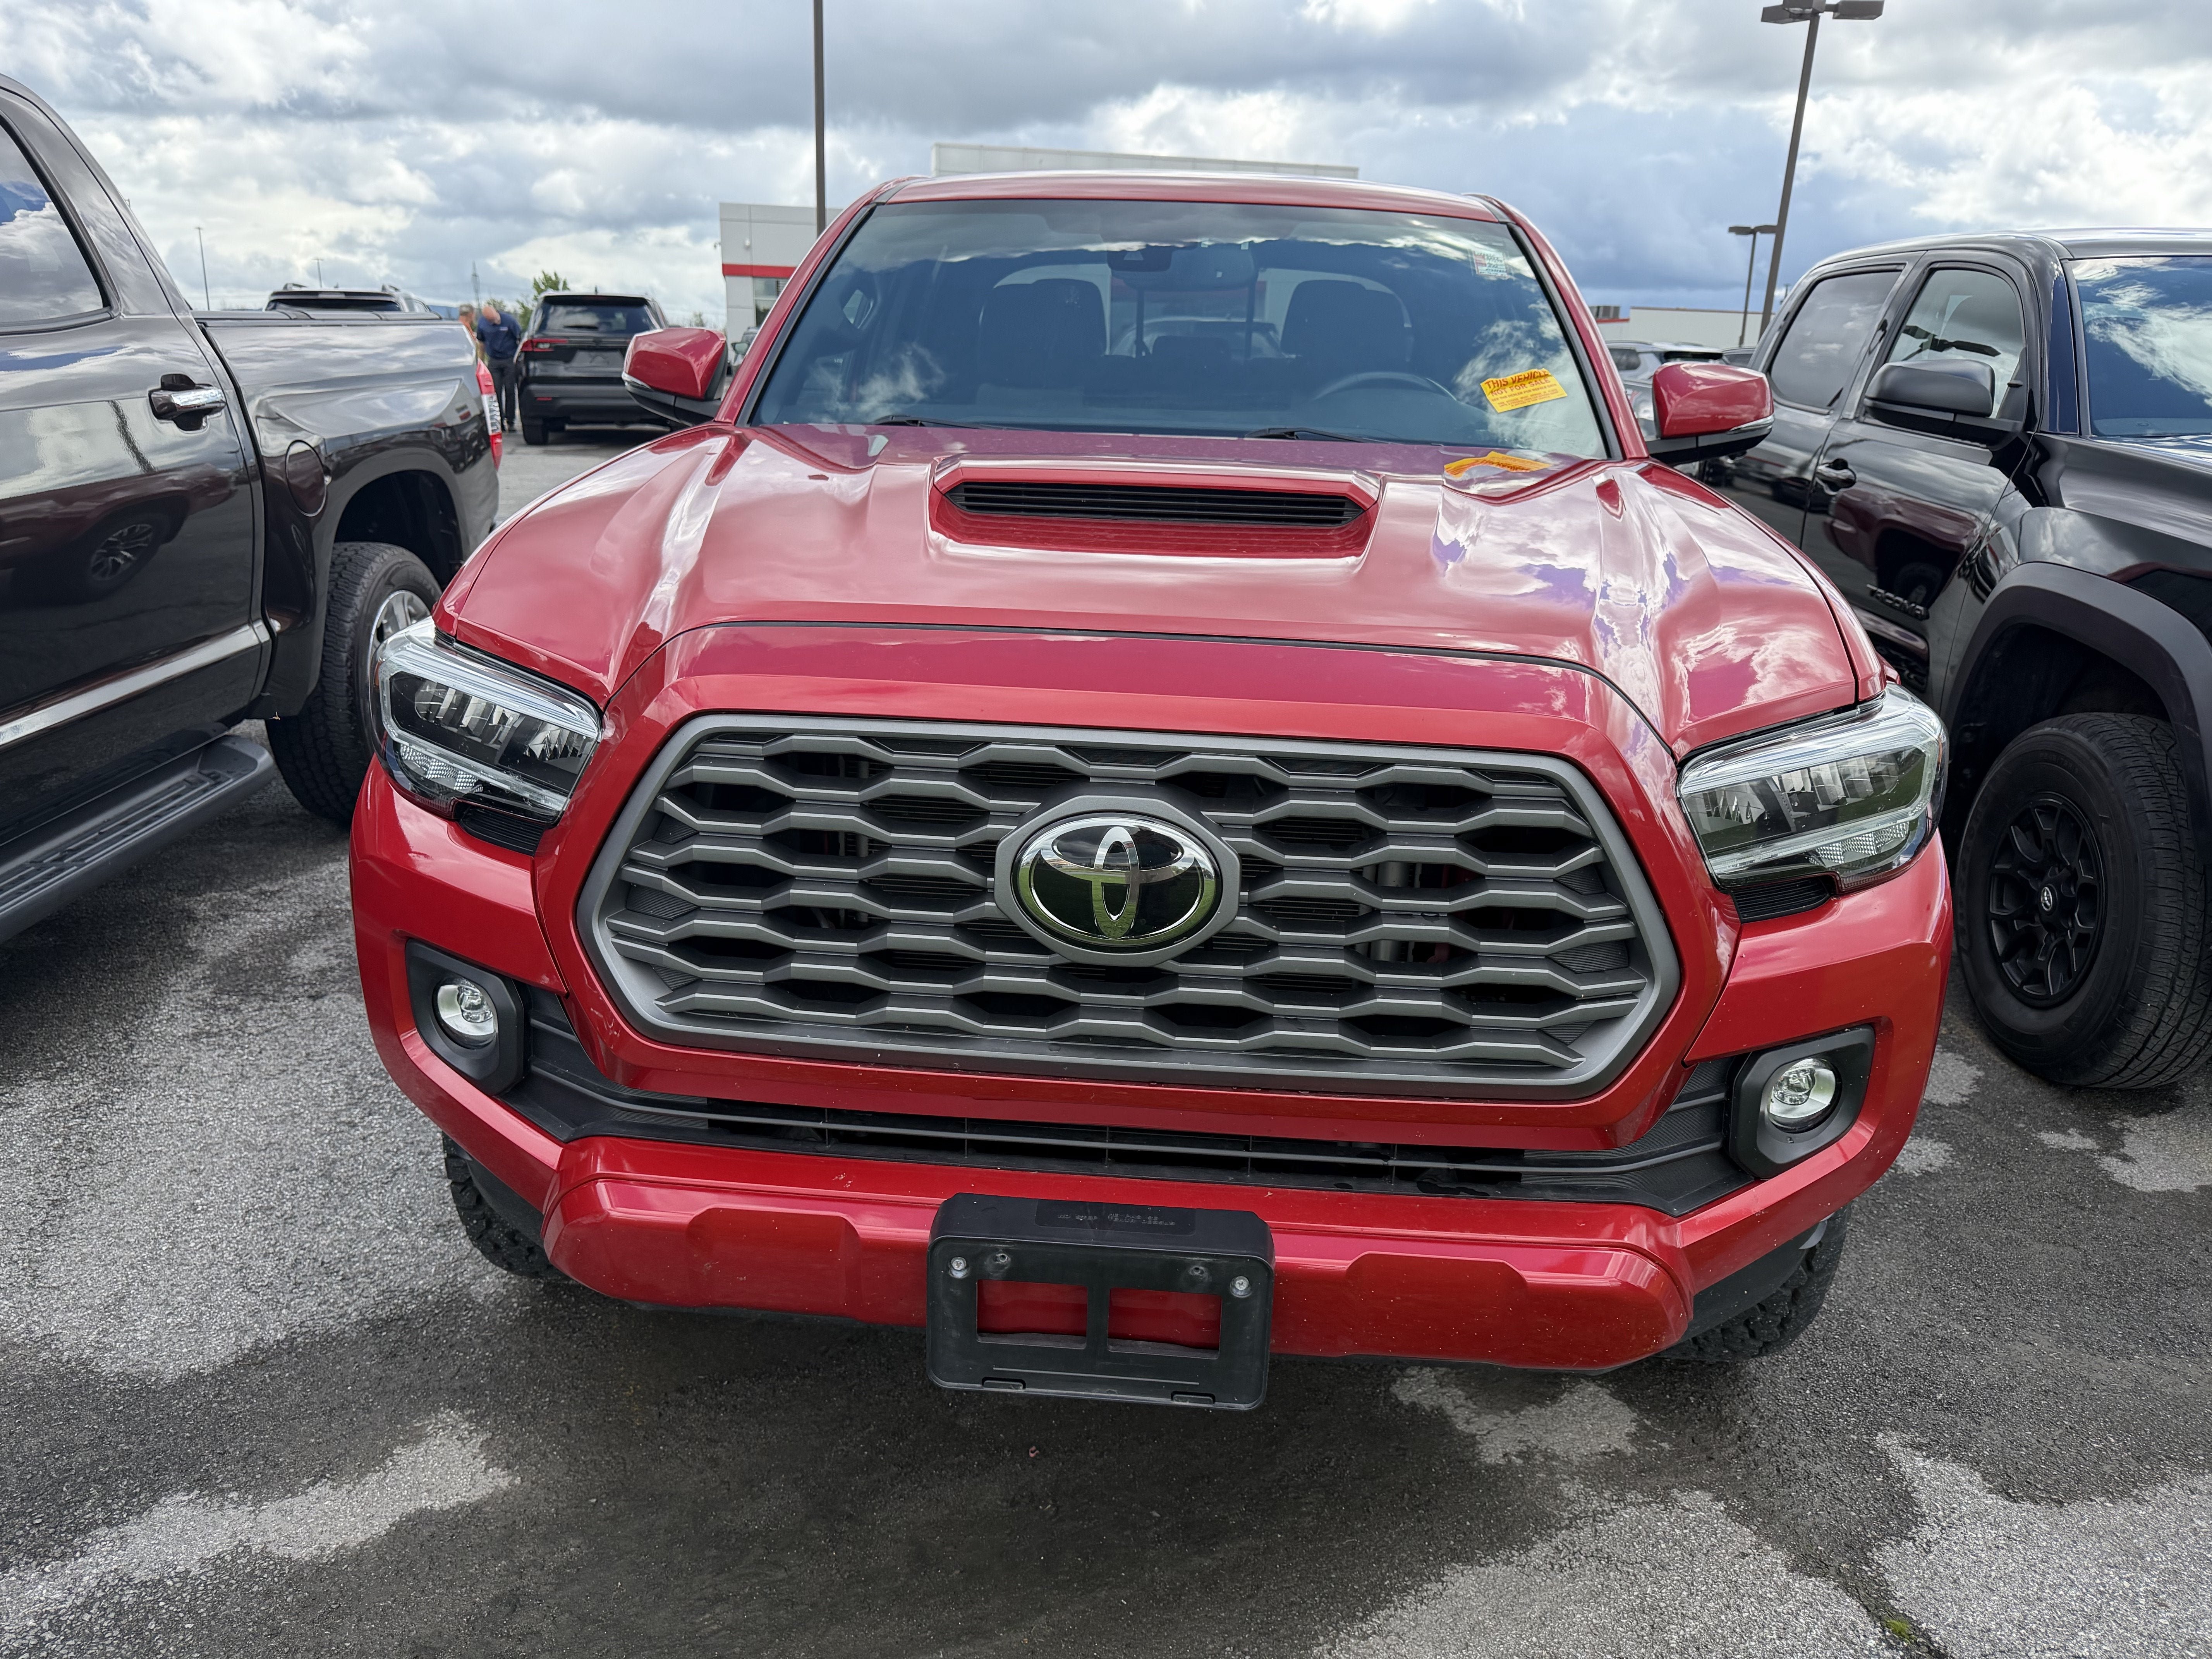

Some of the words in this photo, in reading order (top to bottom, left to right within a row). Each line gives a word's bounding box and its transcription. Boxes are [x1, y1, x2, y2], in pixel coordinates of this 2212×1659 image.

[1484, 378, 1509, 389] THIS
[1511, 370, 1549, 383] VEHICLE
[1491, 388, 1508, 397] NOT
[1510, 383, 1528, 392] FOR
[1528, 378, 1551, 387] SALE
[1867, 584, 1925, 617] TACOMA
